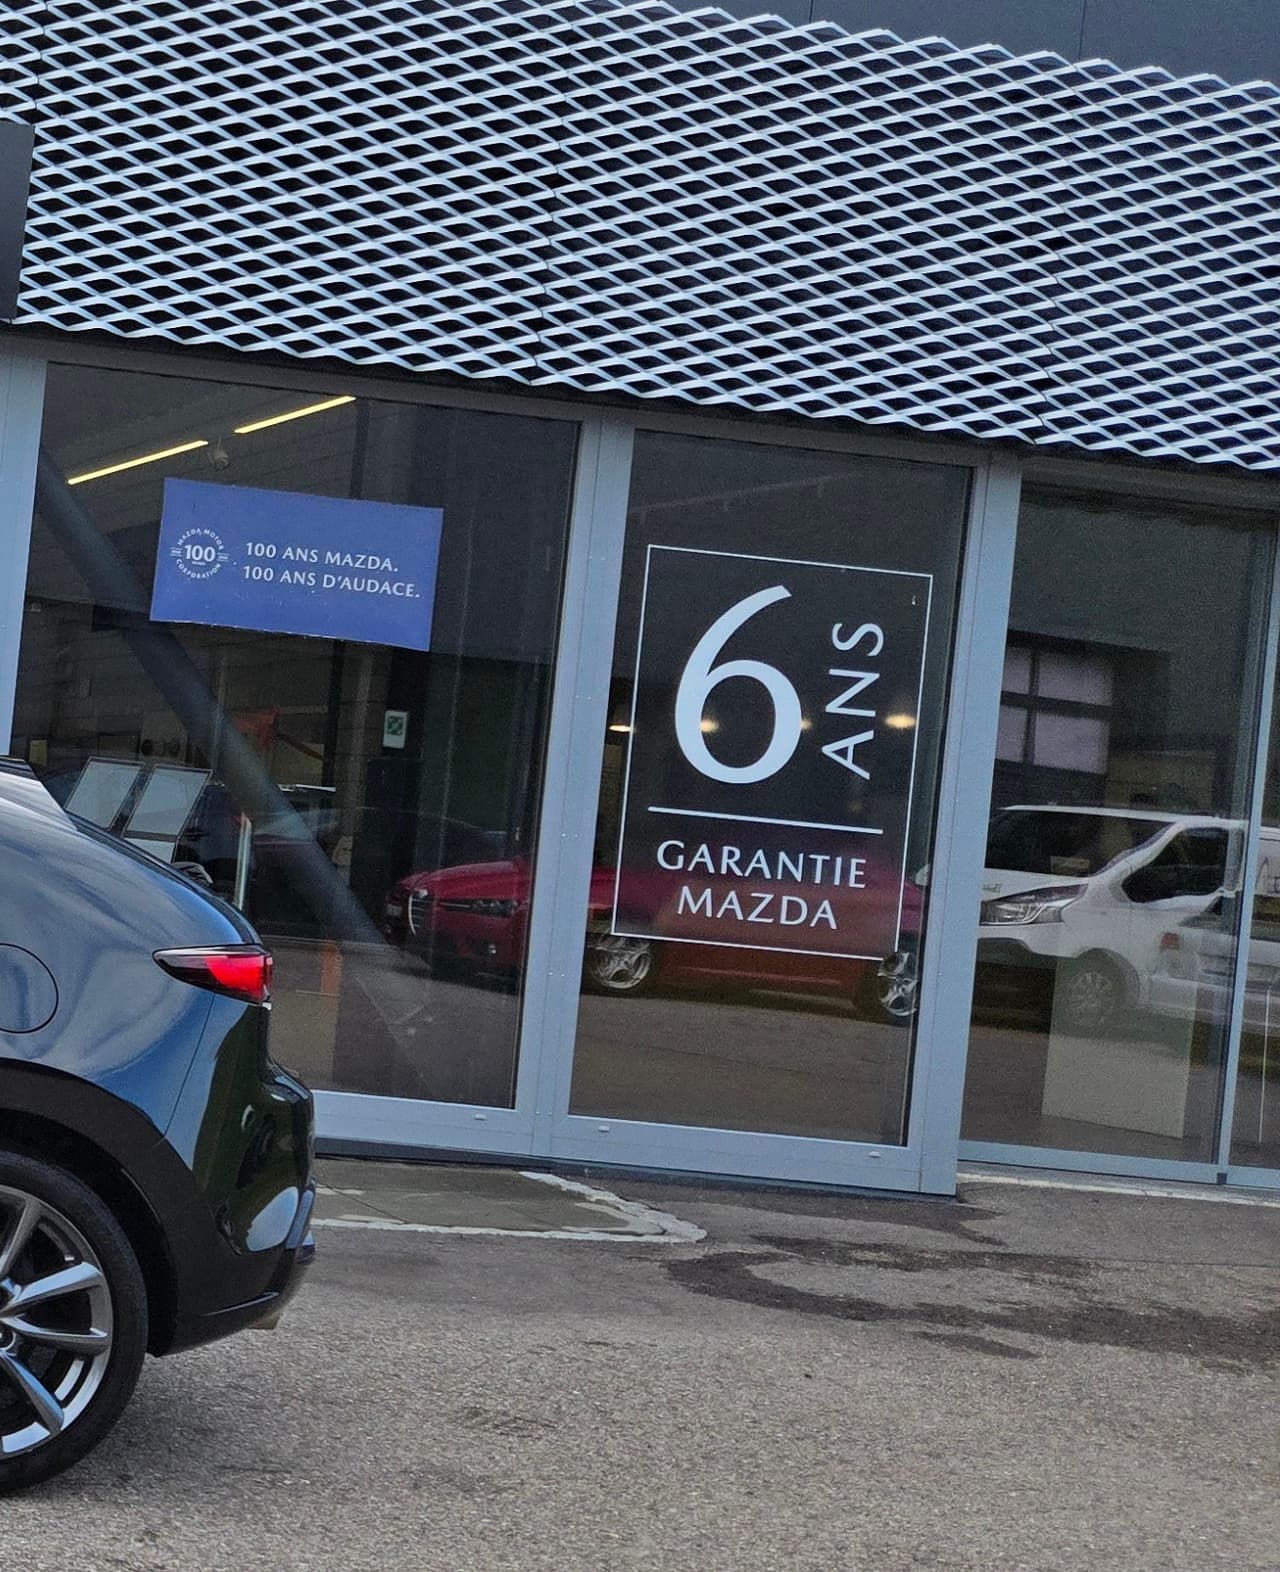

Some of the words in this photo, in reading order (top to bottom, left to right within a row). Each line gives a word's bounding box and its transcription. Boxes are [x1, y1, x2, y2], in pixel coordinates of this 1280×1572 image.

[184, 544, 216, 562] 100
[243, 565, 274, 581] 100
[279, 571, 317, 587] ANS
[245, 541, 277, 558] 100
[282, 547, 319, 563] ANS
[324, 551, 399, 573] MAZDA.
[674, 584, 803, 785] 6
[821, 622, 885, 781] ANS
[656, 839, 867, 889] GARANTIE
[677, 885, 838, 931] MAZDA
